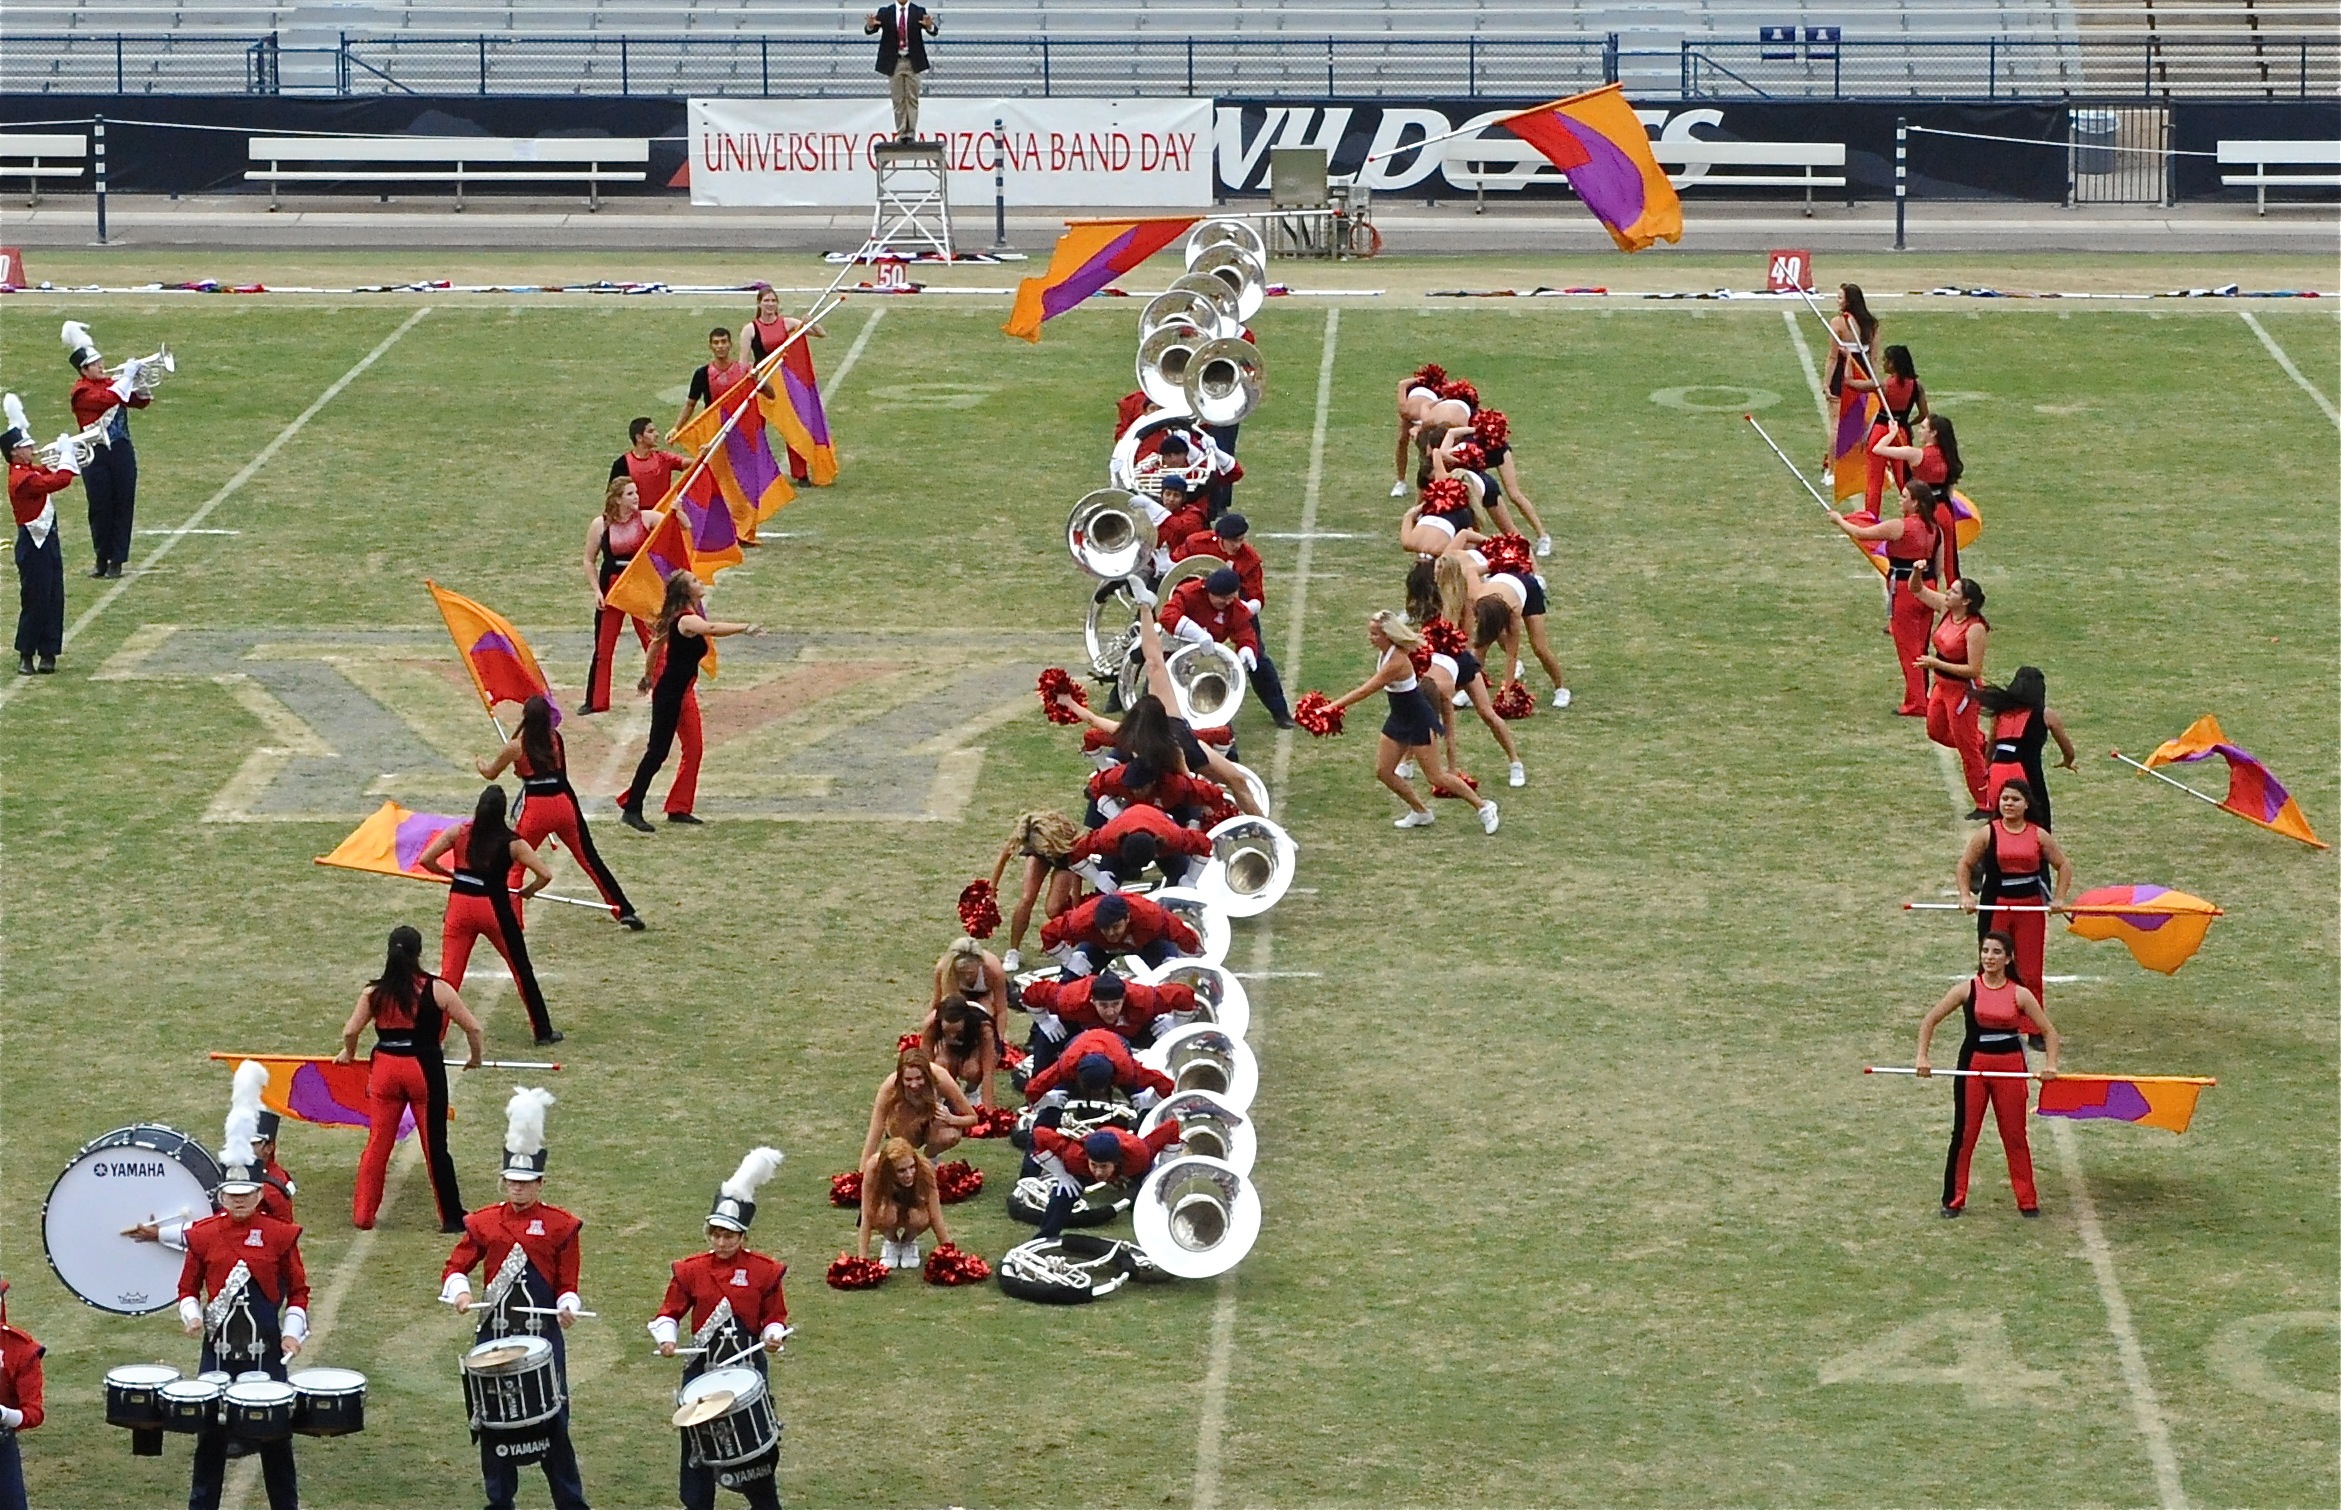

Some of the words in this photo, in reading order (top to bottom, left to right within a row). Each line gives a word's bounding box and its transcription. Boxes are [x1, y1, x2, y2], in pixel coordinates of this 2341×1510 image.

[704, 133, 859, 172] UNIVERSITY
[1050, 133, 1130, 172] BAND
[1140, 133, 1197, 172] DAY
[1213, 107, 1725, 190] WILDCS
[879, 264, 904, 286] 50
[1770, 256, 1801, 286] 40
[110, 1162, 165, 1177] YAMAHA
[509, 1437, 551, 1456] YAMAHA
[733, 1463, 773, 1483] YAMAHA
